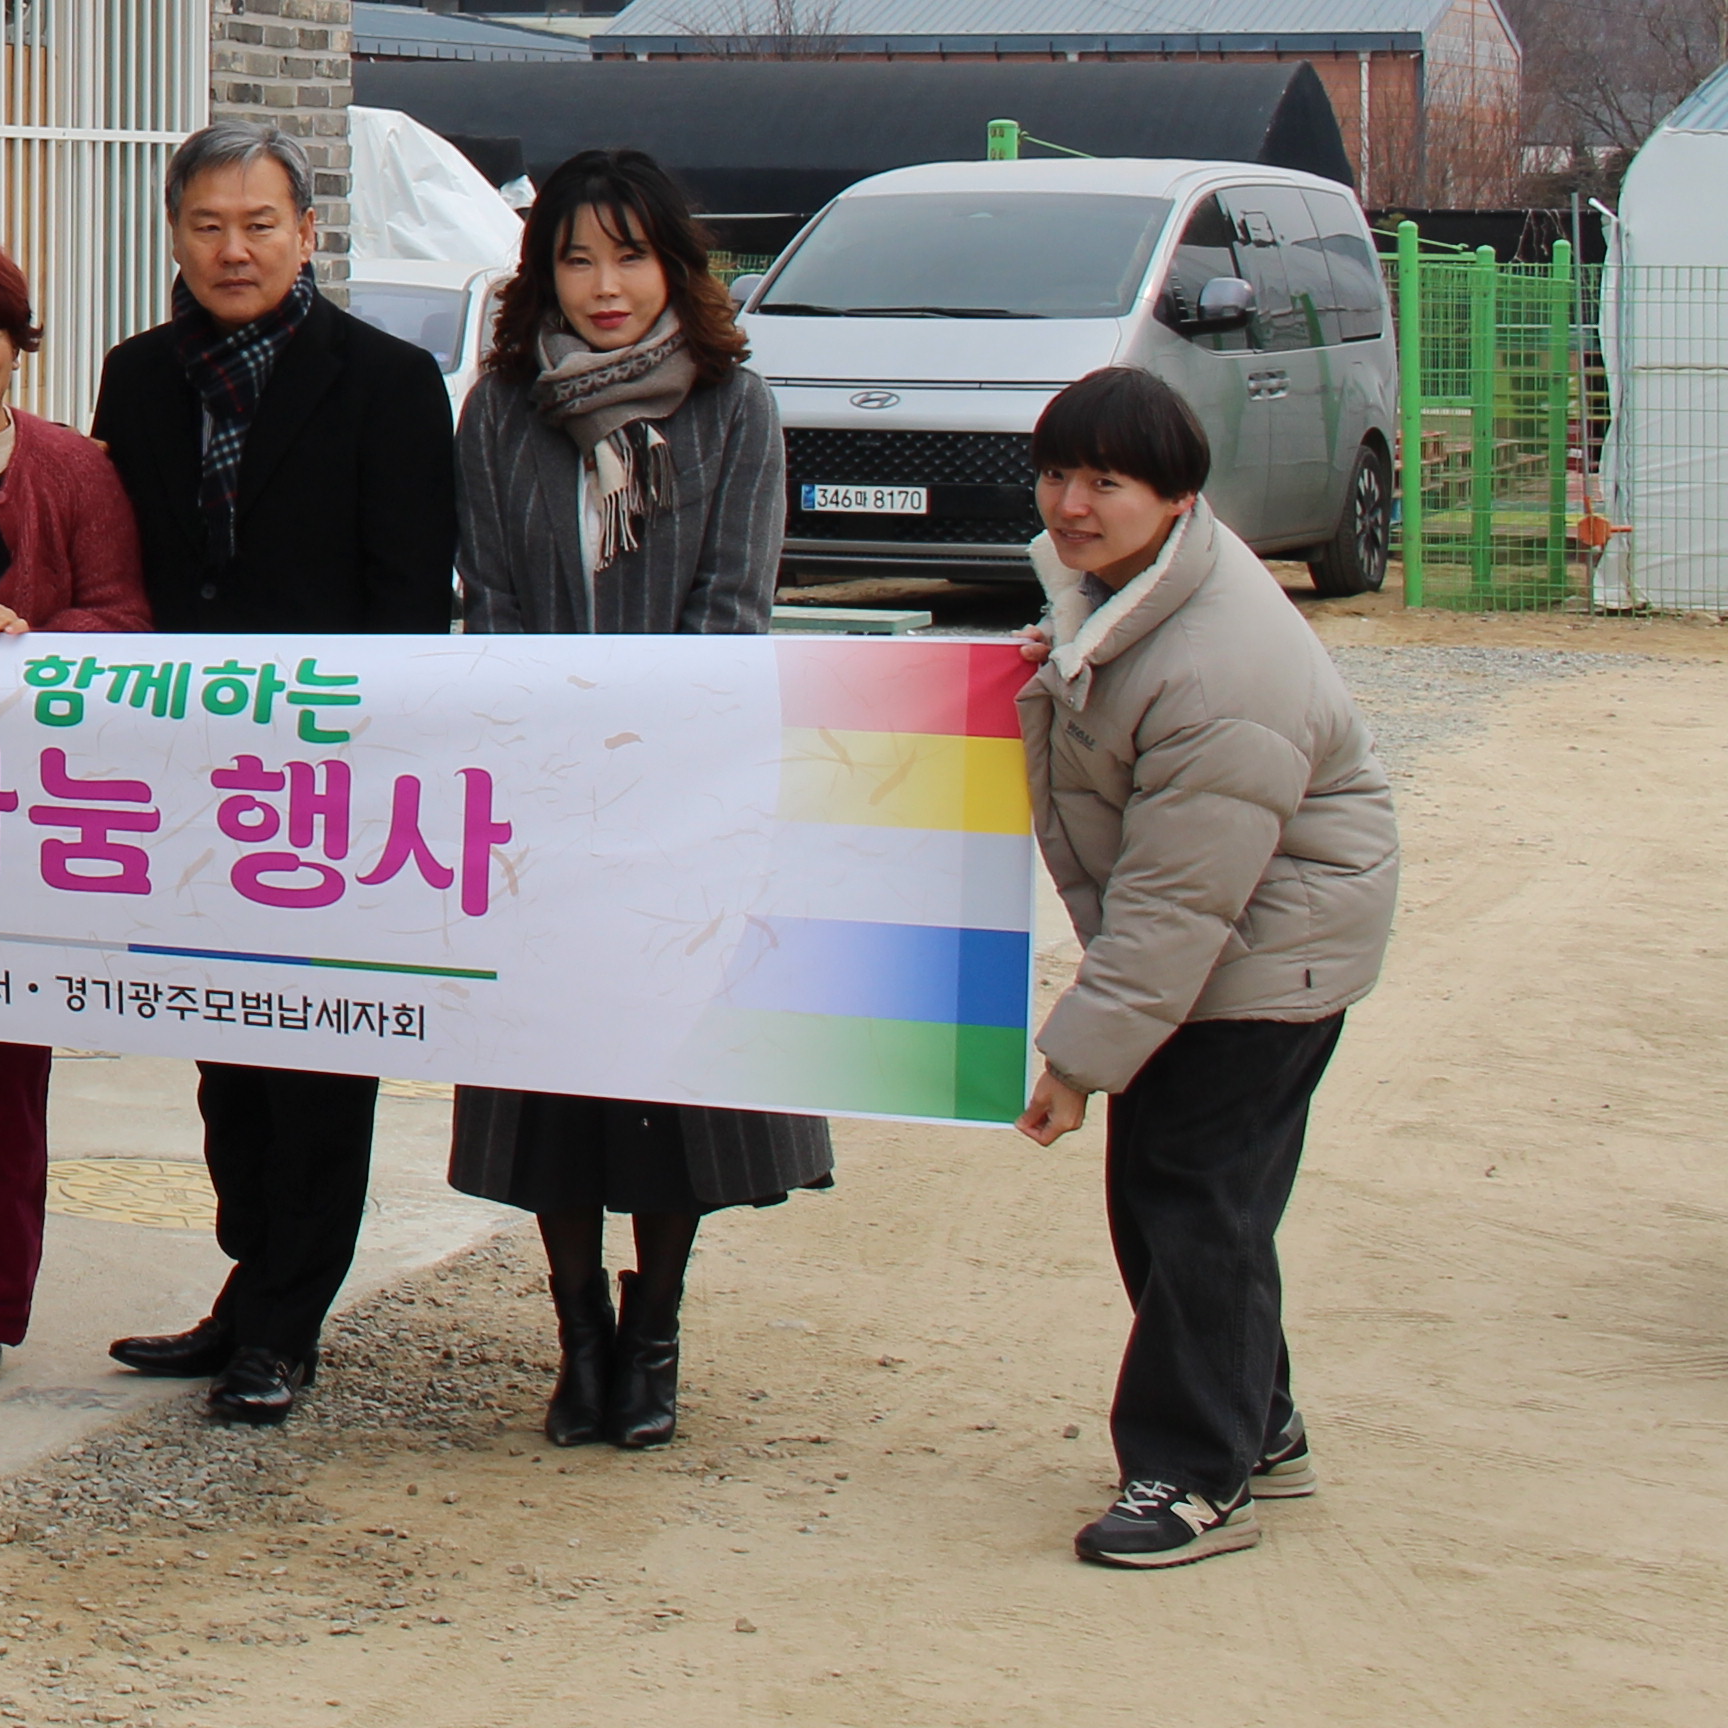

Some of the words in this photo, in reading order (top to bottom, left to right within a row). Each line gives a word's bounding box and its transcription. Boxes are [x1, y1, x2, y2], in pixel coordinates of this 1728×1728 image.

[817, 488, 867, 508] 346마
[873, 489, 922, 510] 8170
[22, 653, 362, 745] 함께하는
[210, 753, 513, 918] 행사
[54, 972, 427, 1043] 경기광주모범납세자회
